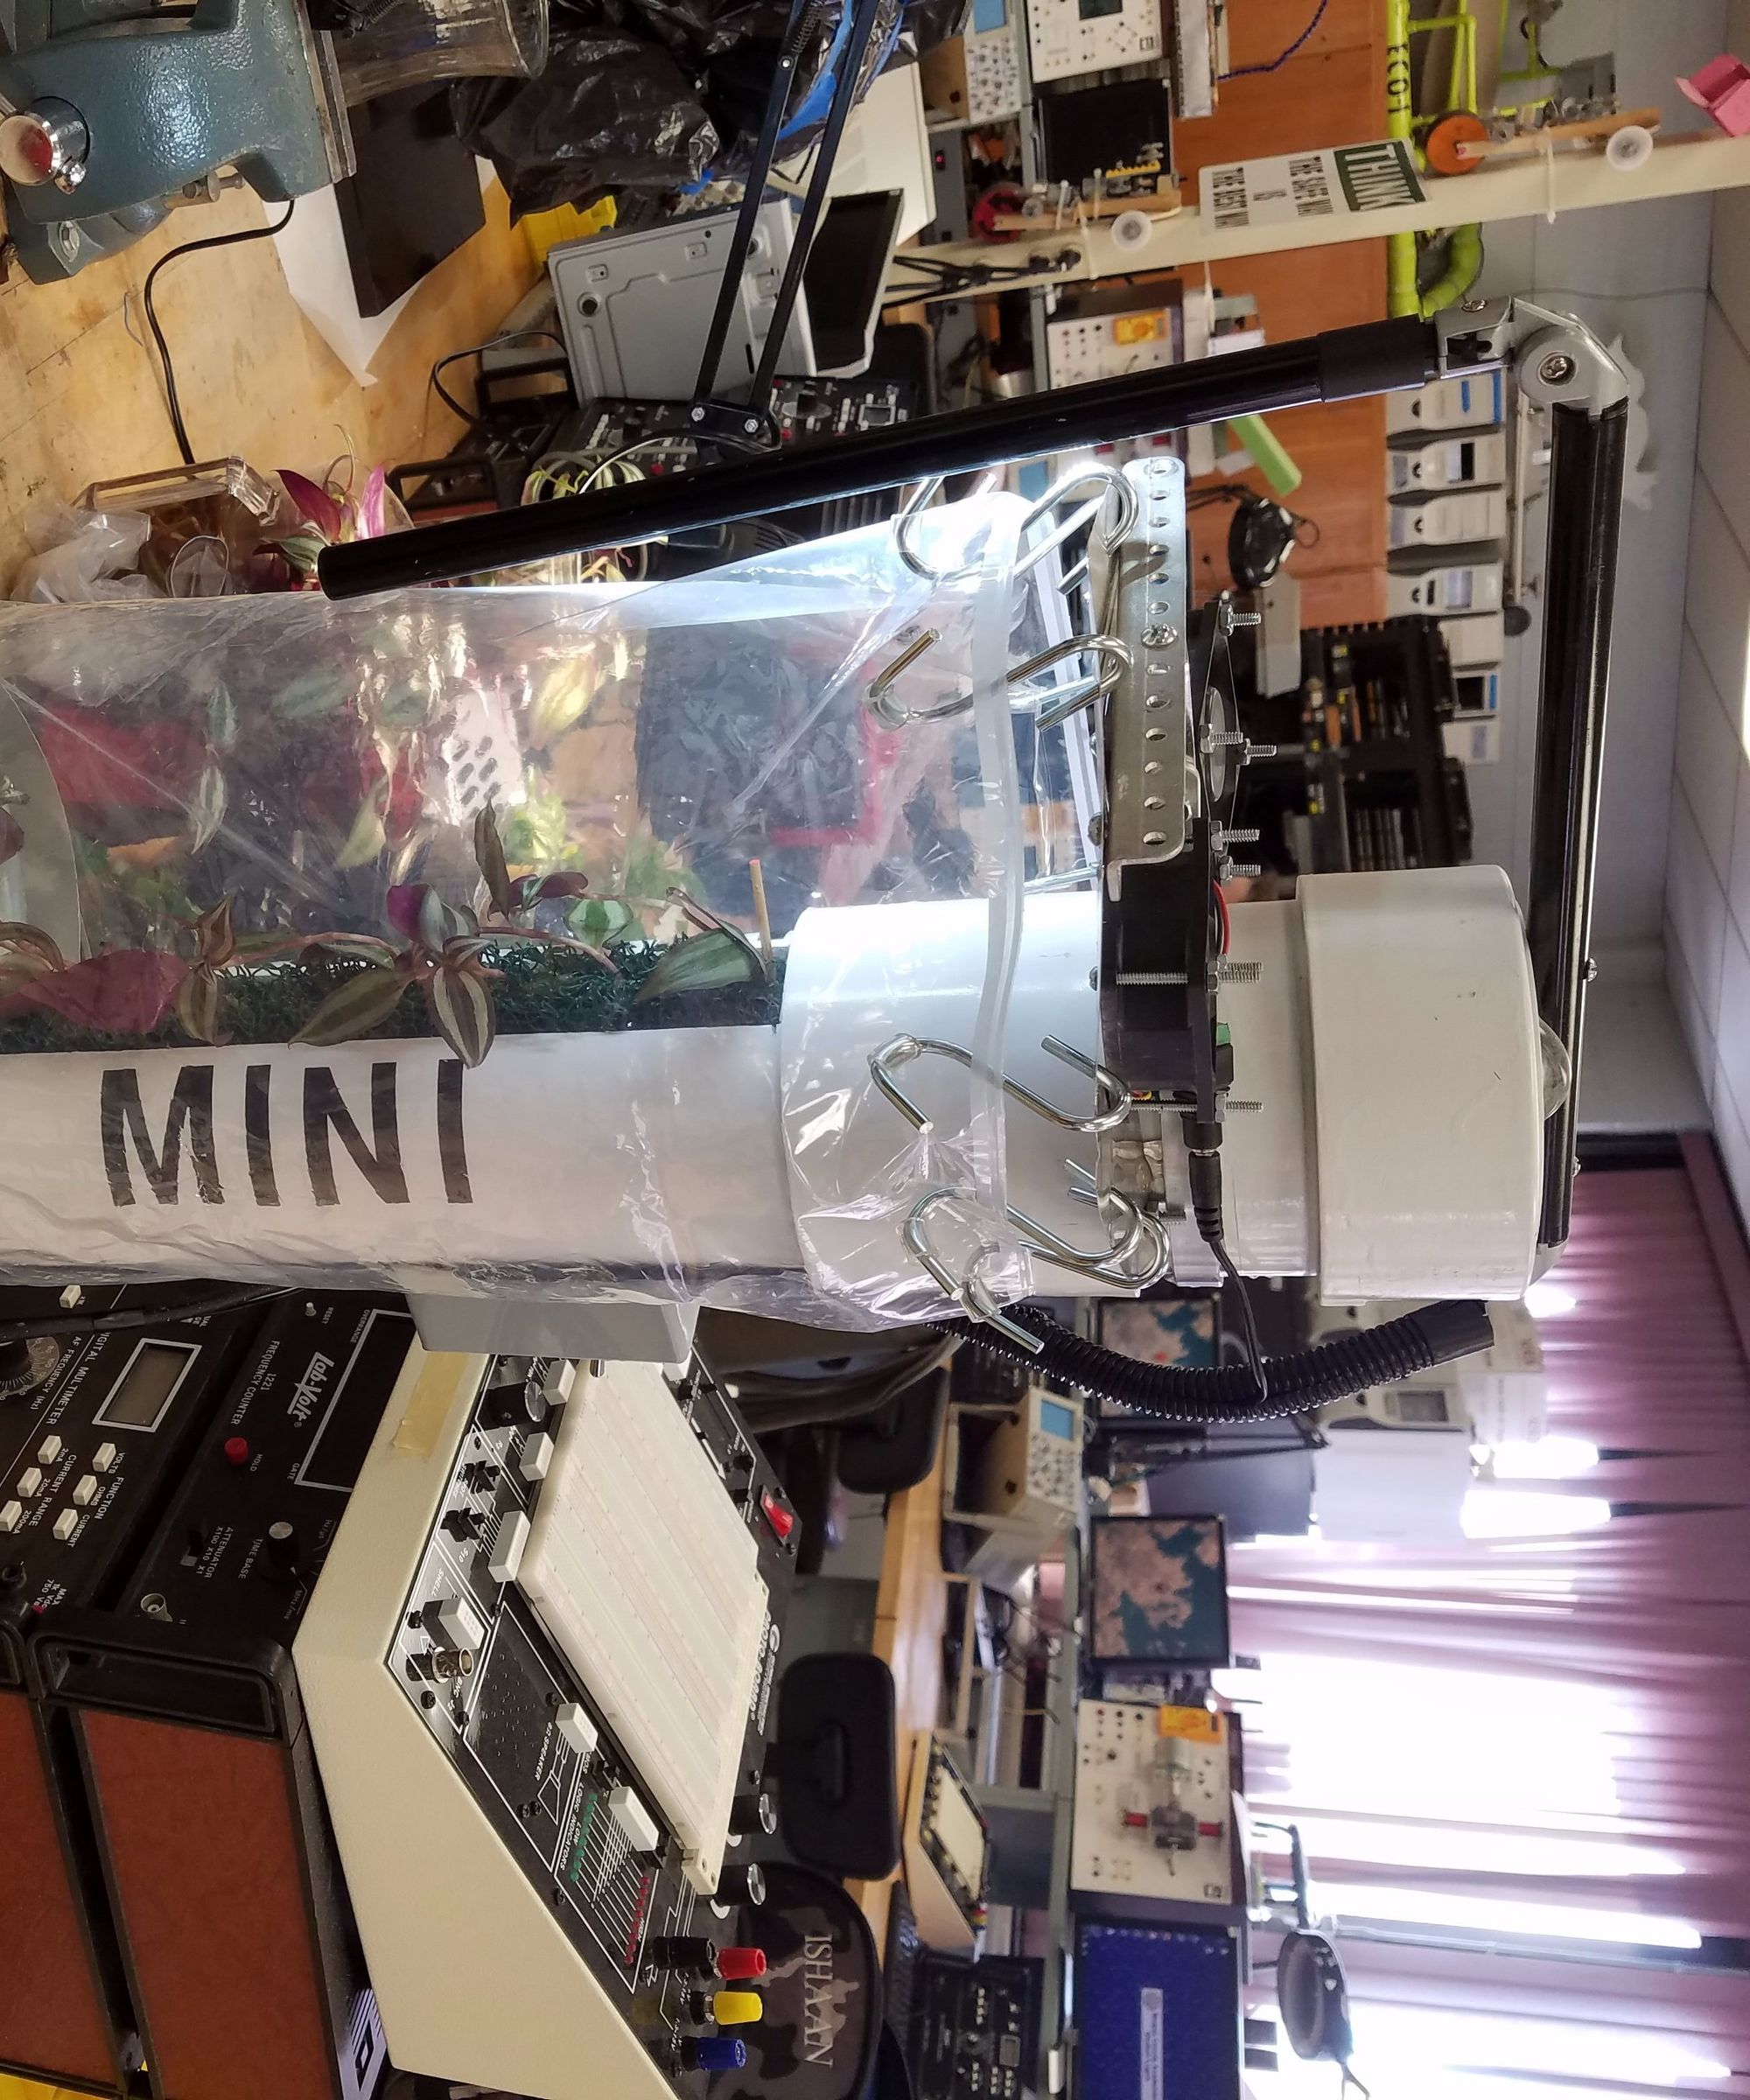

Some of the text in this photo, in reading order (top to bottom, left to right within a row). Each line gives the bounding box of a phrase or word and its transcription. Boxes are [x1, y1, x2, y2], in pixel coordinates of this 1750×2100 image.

[1213, 168, 1246, 188] THE
[1290, 156, 1324, 177] THE
[1344, 144, 1416, 211] THINK
[1214, 189, 1249, 213] BEST
[1253, 189, 1288, 202] IS
[1292, 177, 1329, 200] SAFE
[101, 1059, 473, 1207] MINI
[321, 1307, 334, 1325] RESET
[350, 1309, 371, 1344] OVERRANGE
[30, 1336, 82, 1410] AF FREQUENCY (Hz)
[46, 1332, 112, 1425] IGITAL MULTIMETER
[230, 1340, 281, 1425] FREQUENCY COUNTER
[260, 1373, 277, 1391] 1221
[287, 1351, 335, 1422] Lab-Volt
[54, 1447, 69, 1462] 2mA
[108, 1452, 126, 1474] VOLTS
[249, 1453, 263, 1473] HOLD
[287, 1462, 301, 1480] GATE
[452, 1464, 466, 1499] SWITCHES
[28, 1454, 77, 1527] CURRENT RANGE
[33, 1478, 52, 1497] 20mA
[90, 1486, 106, 1506] OHMS
[94, 1476, 125, 1520] FUNCTION
[460, 1478, 469, 1499] SPDT
[12, 1510, 31, 1534] 200mA
[66, 1514, 91, 1548] CURRENT
[196, 1526, 224, 1574] X100 X10 X1
[204, 1526, 234, 1578] ATTENUATOR
[238, 1537, 264, 1579] TIME BASE
[41, 1578, 54, 1593] 750
[430, 1567, 445, 1598] SHELL
[51, 1587, 67, 1606] MAX
[452, 1676, 463, 1698] BNC
[535, 1736, 550, 1782] SPEAKER
[559, 1782, 584, 1871] LOGIC INDICATORS
[573, 1822, 582, 1847] LOW
[637, 1917, 646, 1942] HIGH
[803, 1934, 834, 2070] ISHAAN
